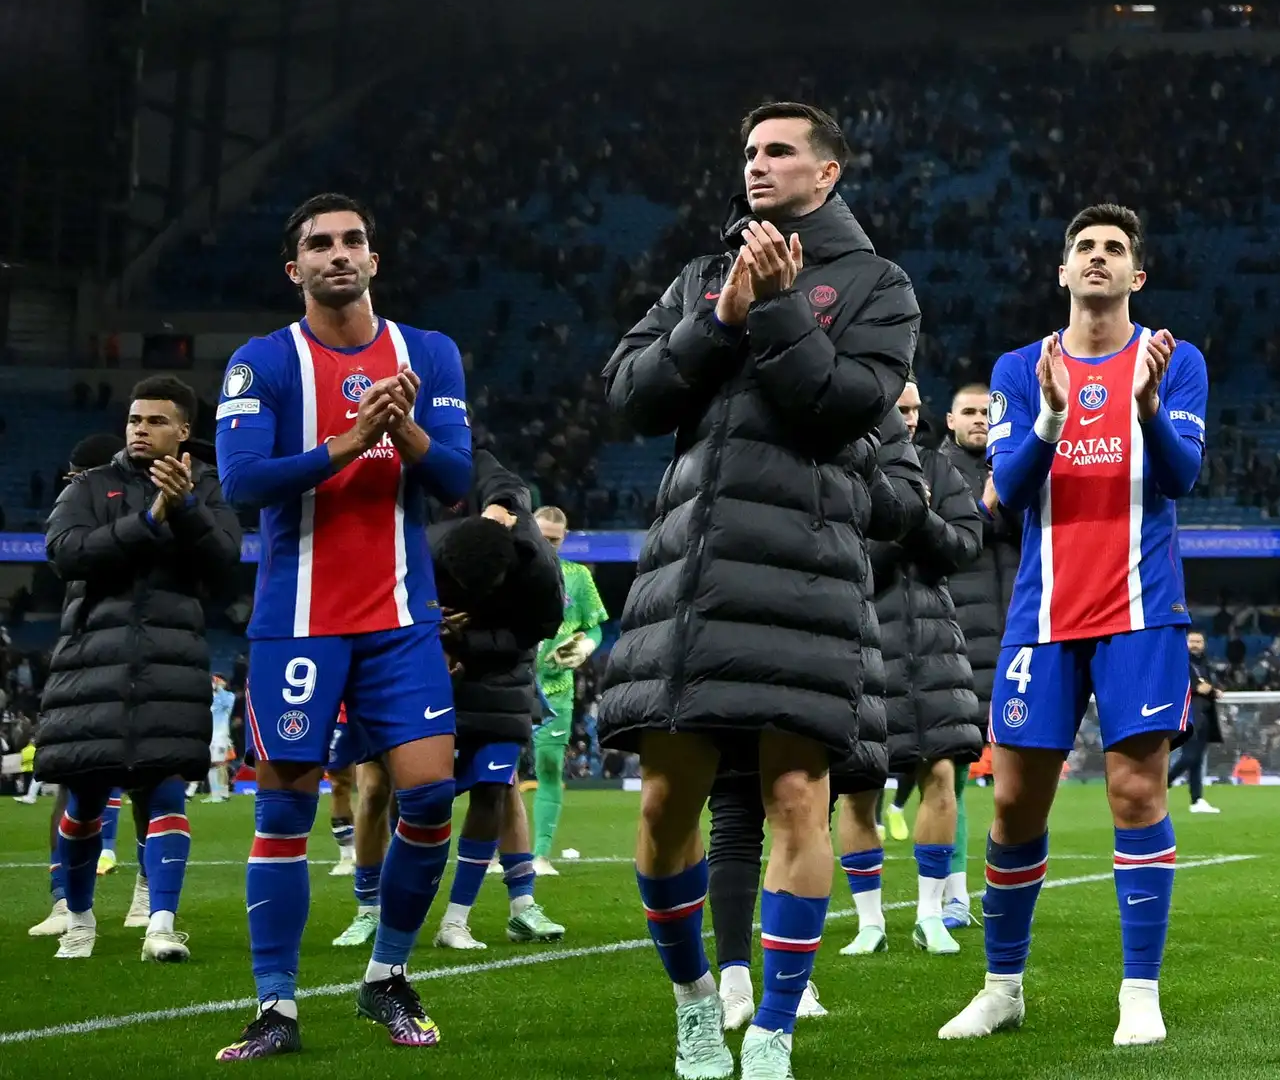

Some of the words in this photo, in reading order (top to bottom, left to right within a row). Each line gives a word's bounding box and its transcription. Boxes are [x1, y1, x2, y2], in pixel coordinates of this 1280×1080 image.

[1056, 437, 1122, 458] QATAR
[1072, 452, 1123, 466] AIRWAYS
[282, 656, 318, 705] 9
[1006, 646, 1033, 694] 4
